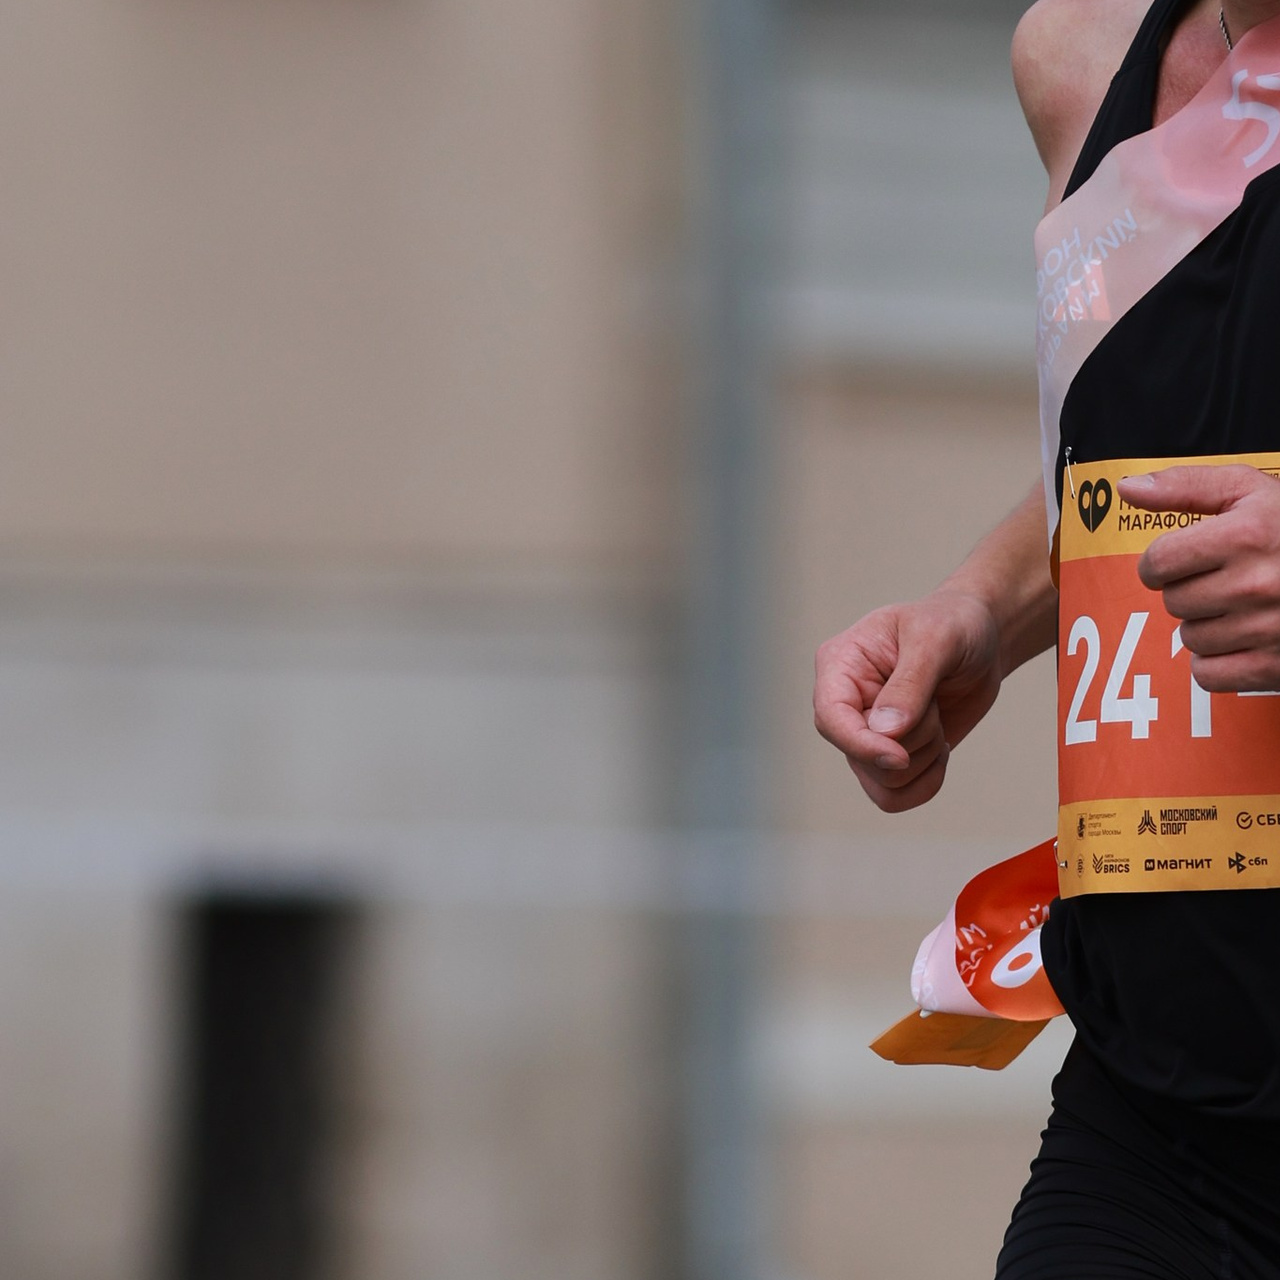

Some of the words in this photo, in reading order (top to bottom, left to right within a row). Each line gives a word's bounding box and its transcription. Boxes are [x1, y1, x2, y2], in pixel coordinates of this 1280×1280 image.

[1118, 512, 1201, 532] МАРАФОН
[1160, 805, 1218, 822] МОСКОВСКИЙ
[1160, 822, 1187, 835] СПОРТ
[1248, 857, 1268, 866] сбп
[1103, 863, 1130, 874] BRICS
